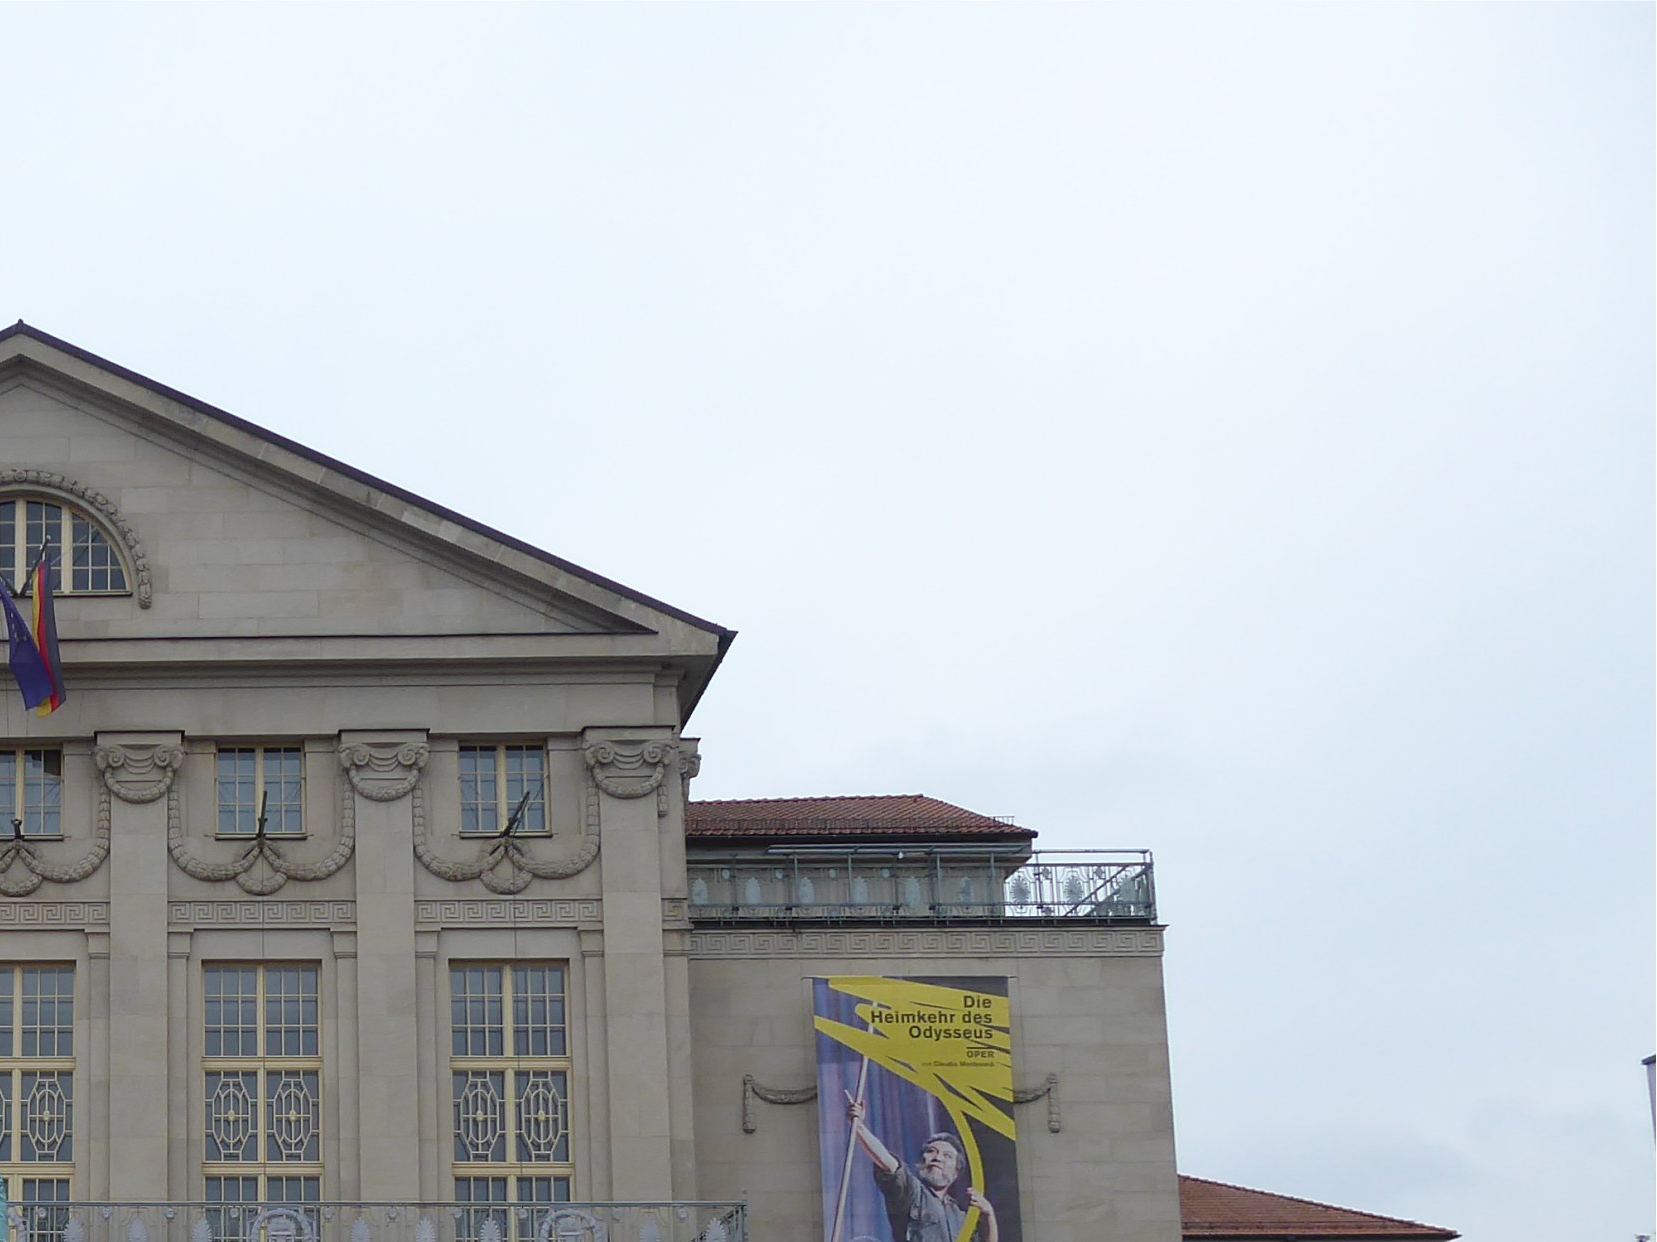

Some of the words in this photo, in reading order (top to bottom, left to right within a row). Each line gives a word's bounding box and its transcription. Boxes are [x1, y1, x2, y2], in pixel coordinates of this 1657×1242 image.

[963, 995, 992, 1008] Die
[870, 1010, 956, 1024] Heimkehr
[962, 1010, 993, 1024] des
[909, 1025, 994, 1041] Odysseus
[966, 1050, 995, 1058] OPER
